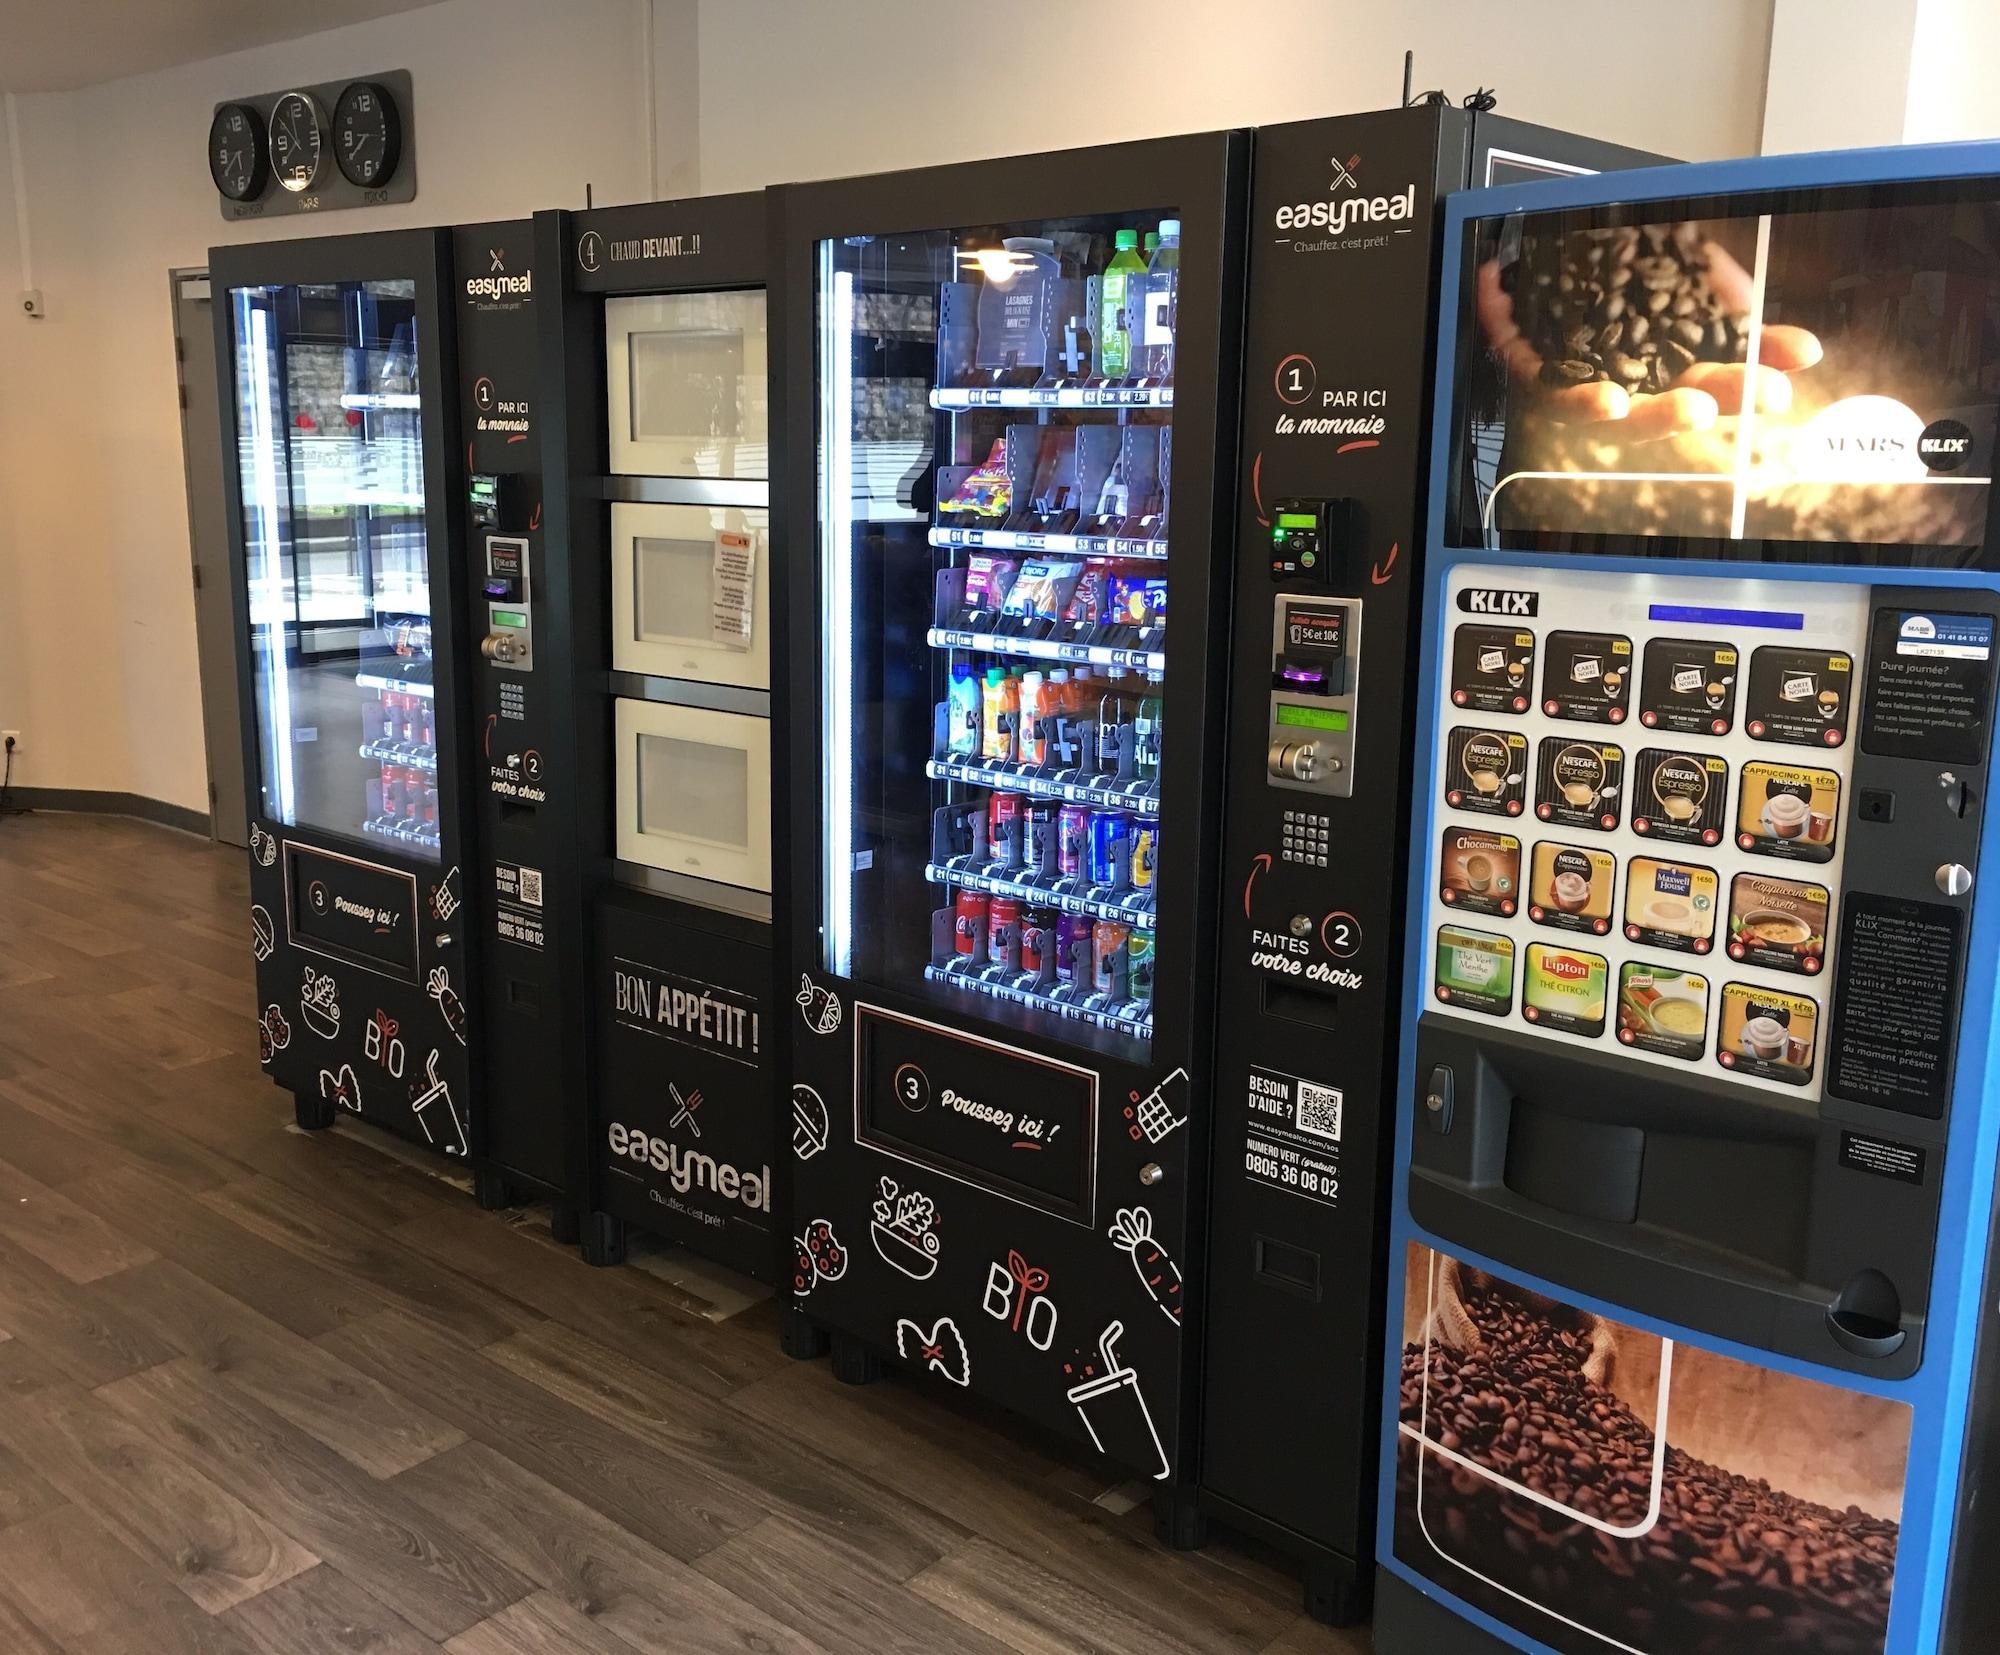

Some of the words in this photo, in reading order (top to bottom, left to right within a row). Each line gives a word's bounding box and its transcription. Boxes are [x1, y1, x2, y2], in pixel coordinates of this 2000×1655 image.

[1275, 184, 1415, 235] easymeal
[586, 237, 595, 265] 4
[610, 240, 641, 262] CHAUD
[466, 269, 532, 301] easymeal
[1005, 295, 1033, 306] LASAGNES
[1288, 368, 1303, 391] 1
[480, 386, 489, 403] 1
[1322, 390, 1358, 408] PAR
[1363, 390, 1387, 407] ICI
[498, 402, 516, 414] PAR
[517, 402, 529, 414] ICI
[477, 416, 487, 431] la
[488, 418, 530, 432] monnaie
[1275, 413, 1296, 435] la
[1298, 414, 1386, 435] monnaie
[1077, 539, 1089, 550] 53
[1116, 540, 1128, 552] 54
[1155, 542, 1167, 554] 55
[1470, 590, 1531, 615] KLIX
[1113, 652, 1125, 663] 44
[1717, 654, 1735, 663] 1€50
[1830, 660, 1848, 670] 1€50
[1880, 661, 1904, 671] Dure
[1677, 673, 1698, 683] CARTE
[1678, 678, 1699, 689] NOIRE
[1787, 681, 1810, 691] CARTE
[1788, 686, 1811, 697] NOIRE
[530, 758, 538, 773] 2
[1467, 752, 1506, 767] Espresso
[490, 766, 520, 781] FAITES
[936, 764, 946, 775] 31
[1558, 765, 1600, 780] Espresso
[1743, 765, 1800, 780] CAPPUCCINO
[1802, 774, 1813, 783] XL
[491, 779, 517, 797] votre
[518, 786, 546, 802] choix
[1658, 776, 1702, 793] Espresso
[1075, 788, 1087, 799] 35
[1109, 794, 1121, 805] 36
[1147, 800, 1158, 811] 37
[936, 870, 946, 880] 21
[1657, 872, 1691, 887] Maxwell
[1696, 875, 1713, 884] 1€50
[1660, 881, 1686, 893] House
[1751, 880, 1808, 899] Cappuccino
[1033, 891, 1044, 902] 24
[1759, 895, 1798, 911] Noisette
[314, 890, 323, 907] 3
[335, 896, 375, 924] Poussez
[377, 907, 391, 925] ici
[1069, 899, 1081, 910] 25
[1107, 907, 1119, 918] 26
[1855, 919, 1878, 930] KLIX
[498, 921, 515, 938] 0805
[515, 926, 525, 940] 36
[525, 928, 535, 943] 08
[535, 931, 545, 946] 02
[1334, 924, 1350, 947] 2
[1877, 930, 1922, 945] Comment?
[1252, 929, 1310, 955] FAITES
[1457, 950, 1473, 961] Thé
[1475, 955, 1492, 965] Vert
[1251, 951, 1302, 975] votre
[1305, 962, 1363, 989] choix
[1458, 959, 1488, 974] Menthe
[1545, 957, 1586, 977] Lipton
[936, 971, 944, 981] 11
[1849, 977, 1886, 990] qualité
[1895, 976, 1935, 990] garantir
[1937, 982, 1947, 991] la
[967, 979, 977, 990] 12
[1539, 979, 1554, 990] THÉ
[1556, 984, 1590, 998] CITRON
[1035, 999, 1045, 1010] 14
[1724, 986, 1778, 1005] CAPPUCCINO
[1780, 999, 1790, 1008] XL
[615, 970, 651, 1019] BON
[657, 983, 747, 1049] APPÉTIT
[1070, 1008, 1080, 1019] 15
[1106, 1017, 1116, 1029] 16
[1143, 1027, 1153, 1038] 17
[1842, 1044, 1854, 1053] du
[1857, 1047, 1897, 1062] moment
[1904, 1048, 1938, 1061] profitez
[1249, 1074, 1289, 1100] BESOIN
[906, 1077, 919, 1100] 3
[941, 1088, 1014, 1133] Poussez
[1018, 1114, 1045, 1139] ici
[1248, 1092, 1283, 1117] D'AIDE
[1247, 1138, 1279, 1159] NUMERO
[1280, 1147, 1301, 1165] VERT
[608, 1121, 771, 1214] easymeal
[1246, 1153, 1279, 1179] 0805
[1281, 1164, 1299, 1185] 36
[1300, 1170, 1318, 1192] 08
[1320, 1176, 1338, 1199] 02
[982, 1249, 1058, 1351] BIO
